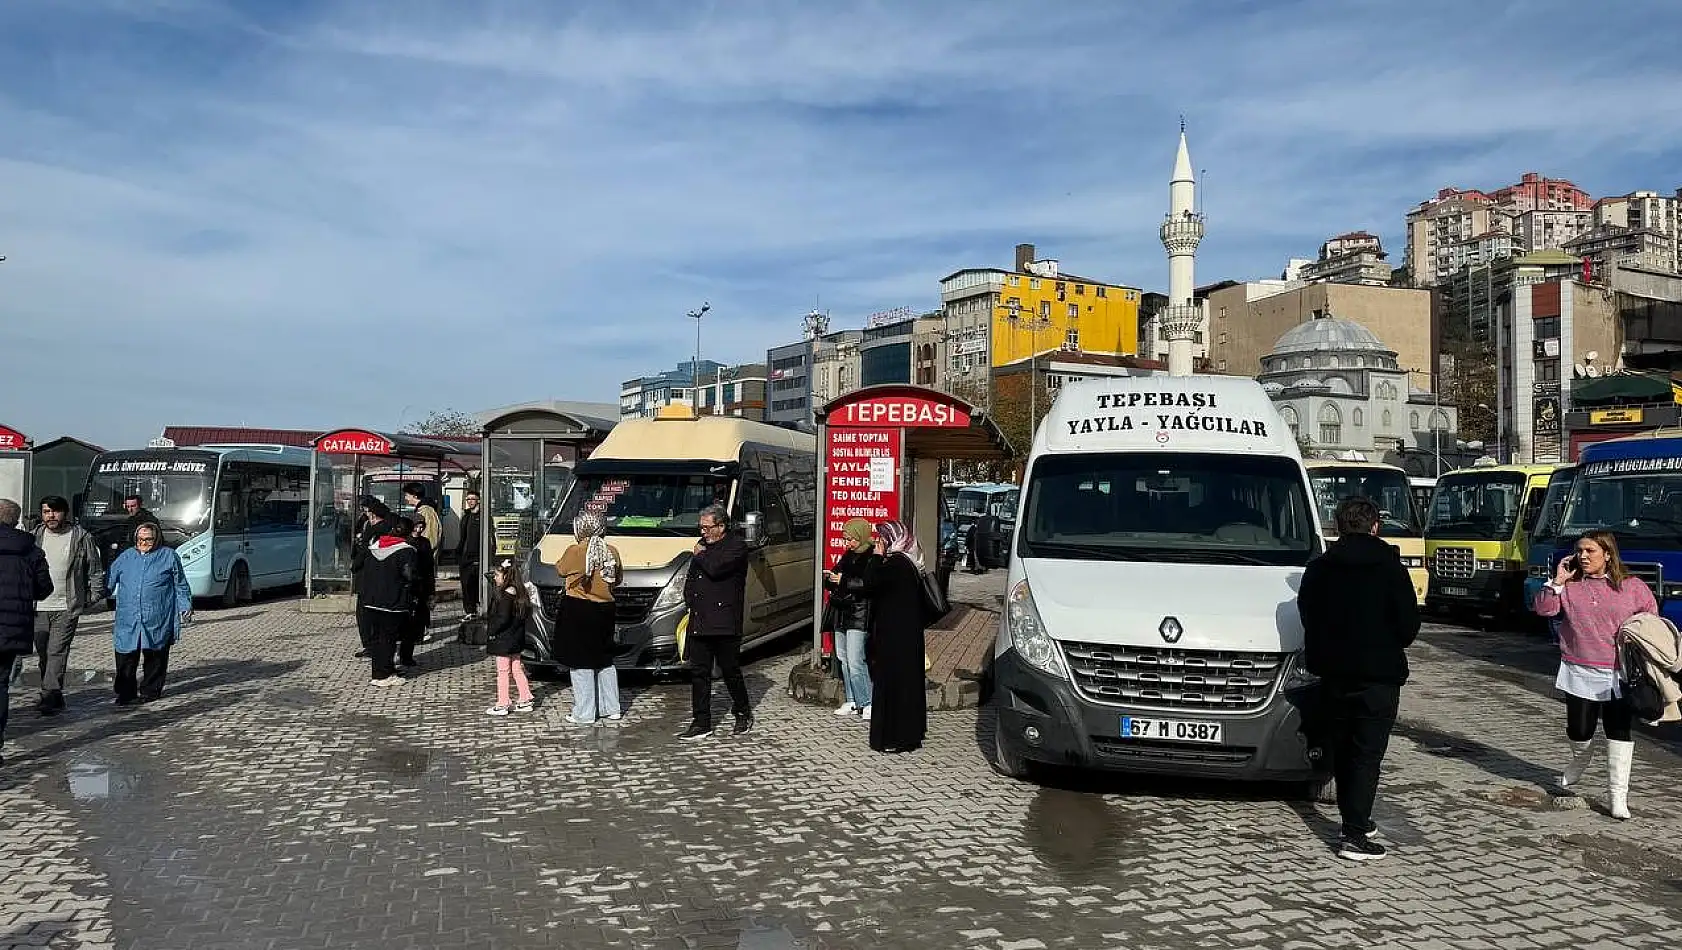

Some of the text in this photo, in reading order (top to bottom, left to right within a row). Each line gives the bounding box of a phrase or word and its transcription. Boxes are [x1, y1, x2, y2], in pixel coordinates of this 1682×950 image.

[1097, 392, 1217, 412] TEPEBAŞI
[845, 403, 955, 426] TEPEBAŞI
[1067, 415, 1134, 434] YAYLA
[1157, 411, 1268, 437] YAĞCILAR
[859, 433, 889, 443] TOPTAN
[324, 438, 384, 451] ÇATALAĞZI
[832, 447, 854, 457] SOSYAL
[833, 462, 870, 472] YAYLA
[832, 477, 869, 487] FENER
[832, 491, 848, 501] TED
[1131, 720, 1151, 736] 67
[1159, 721, 1169, 737] M
[1177, 722, 1220, 741] 0387
